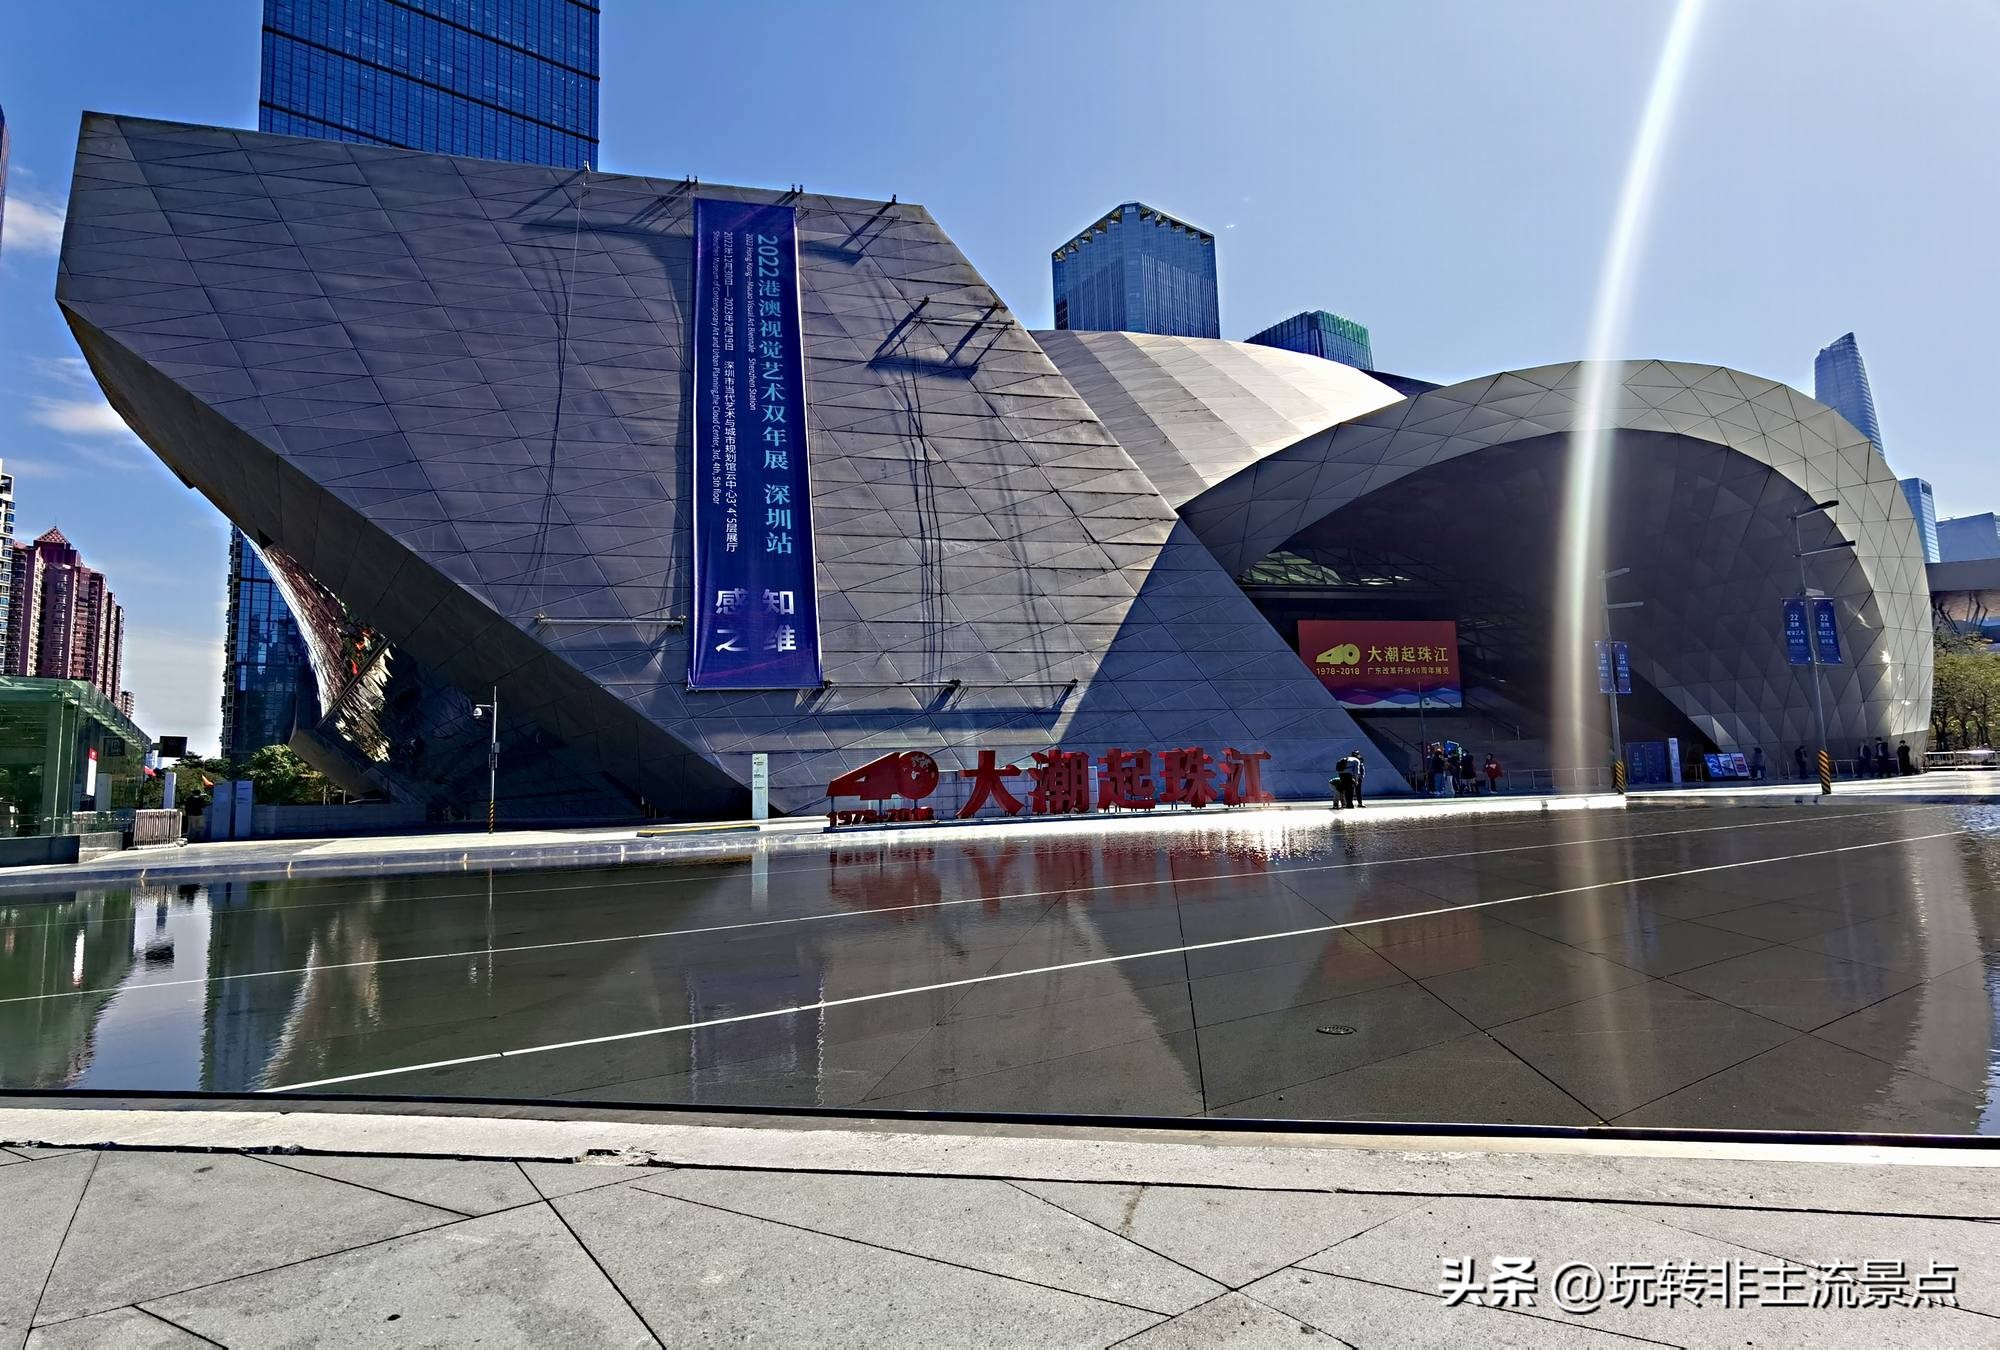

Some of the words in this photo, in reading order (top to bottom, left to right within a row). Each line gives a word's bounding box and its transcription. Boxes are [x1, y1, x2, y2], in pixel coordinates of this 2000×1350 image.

[745, 247, 754, 262] Hong
[710, 287, 721, 327] Contemporary
[746, 300, 756, 318] Visual
[712, 327, 721, 336] Art
[747, 318, 756, 327] Art
[712, 336, 721, 348] and
[747, 327, 757, 353] Biennale
[712, 348, 721, 367] Urban
[758, 234, 790, 471] 2022港澳视觉艺术双年展
[747, 358, 757, 388] Shenzhen
[748, 389, 758, 411] Station
[712, 405, 721, 424] Cloud
[711, 424, 721, 448] Center,
[712, 476, 721, 488] 5th
[712, 488, 722, 505] floor
[763, 483, 792, 555] 深圳站
[1367, 645, 1449, 663] 大潮起珠江
[1316, 667, 1360, 675] 1978-2018
[956, 747, 1274, 818] 大潮起珠江
